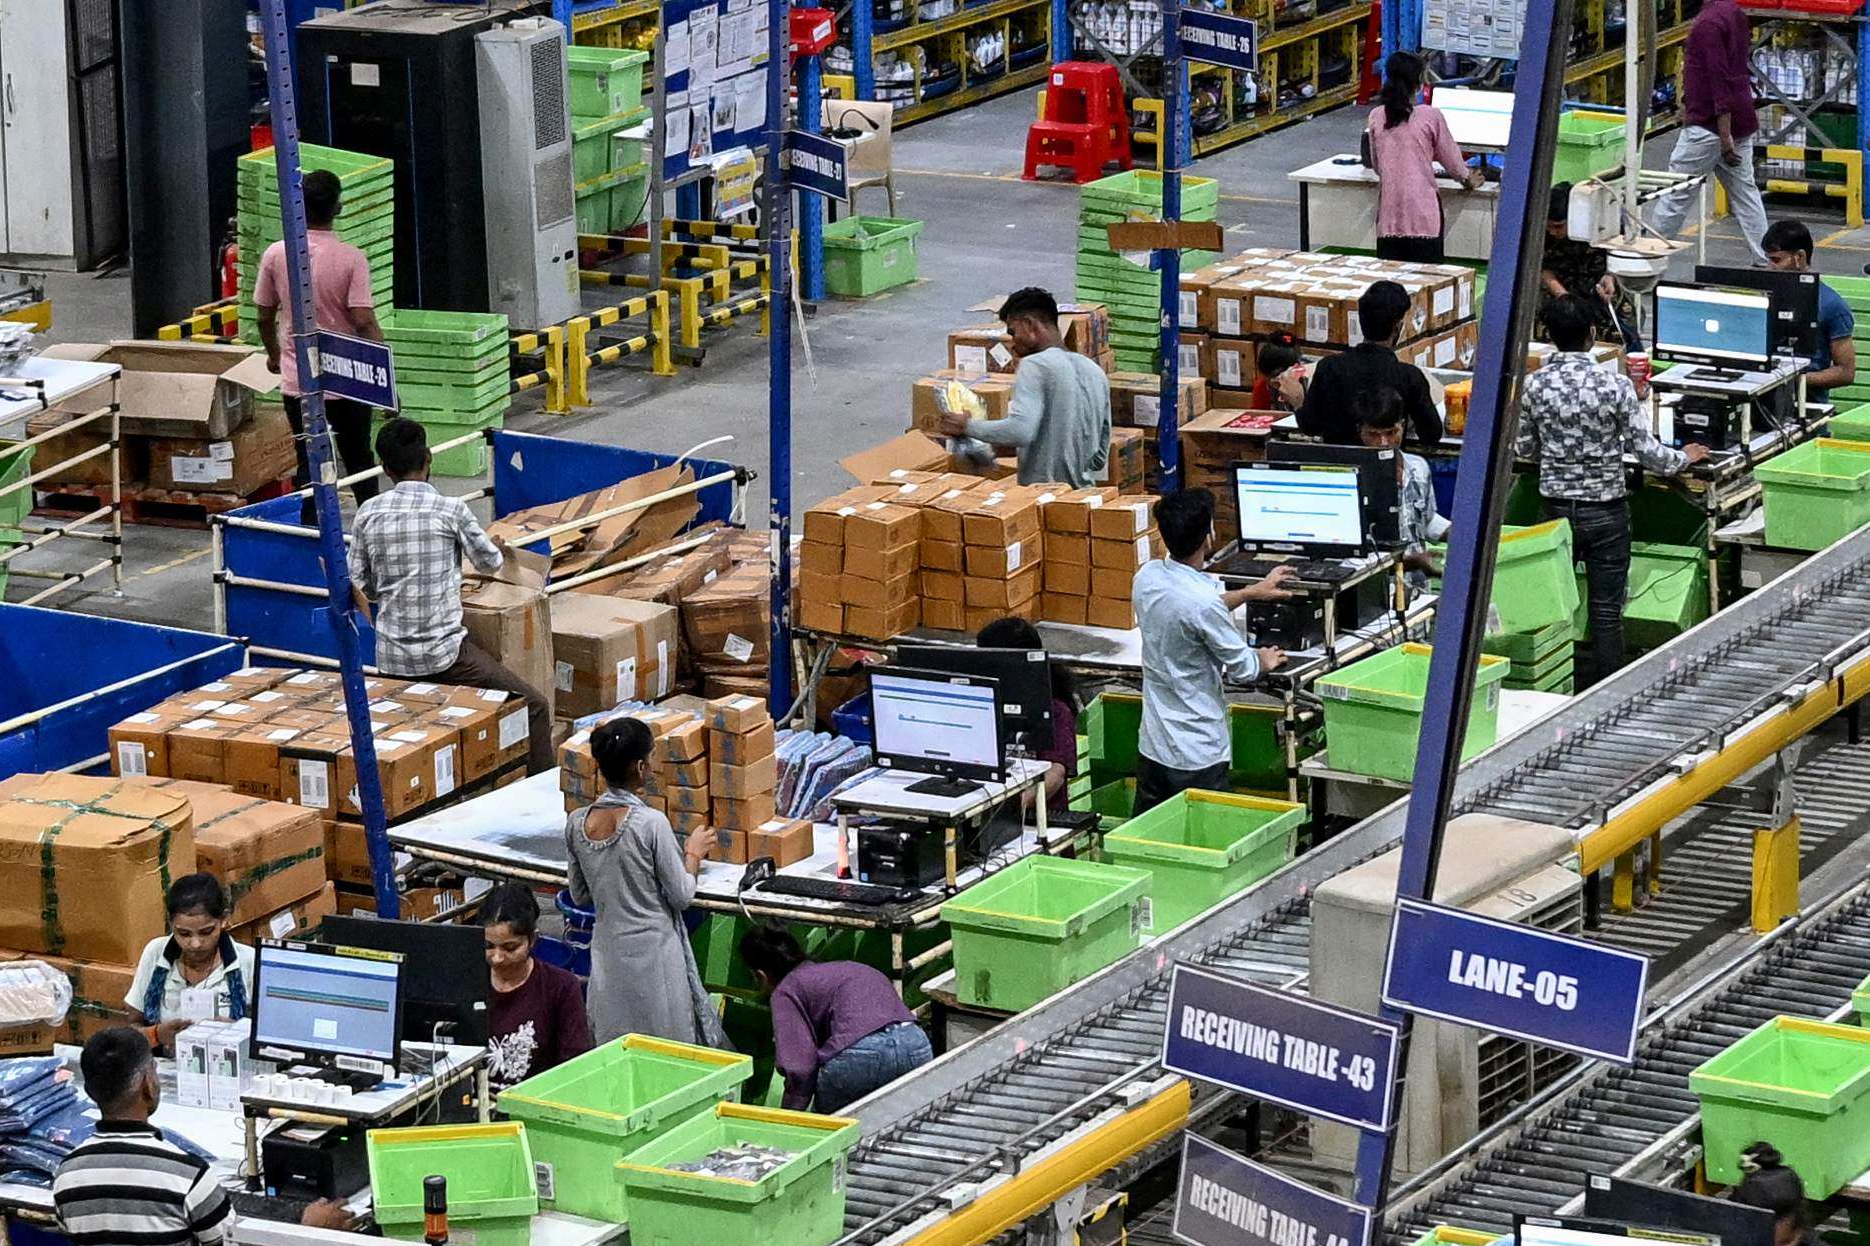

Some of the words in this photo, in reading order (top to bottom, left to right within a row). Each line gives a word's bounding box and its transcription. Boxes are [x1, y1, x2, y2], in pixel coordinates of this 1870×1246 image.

[1216, 31, 1237, 51] TABLE
[818, 156, 834, 178] TABLE
[320, 352, 354, 379] ECEIVING
[353, 360, 376, 385] TABLE
[374, 366, 388, 388] -29
[1448, 949, 1579, 1011] LANE-05
[1181, 1005, 1280, 1064] RECEIVING
[1283, 1033, 1339, 1082] TABLE
[1340, 1053, 1377, 1092] -43
[1189, 1173, 1269, 1238] RECEIVING
